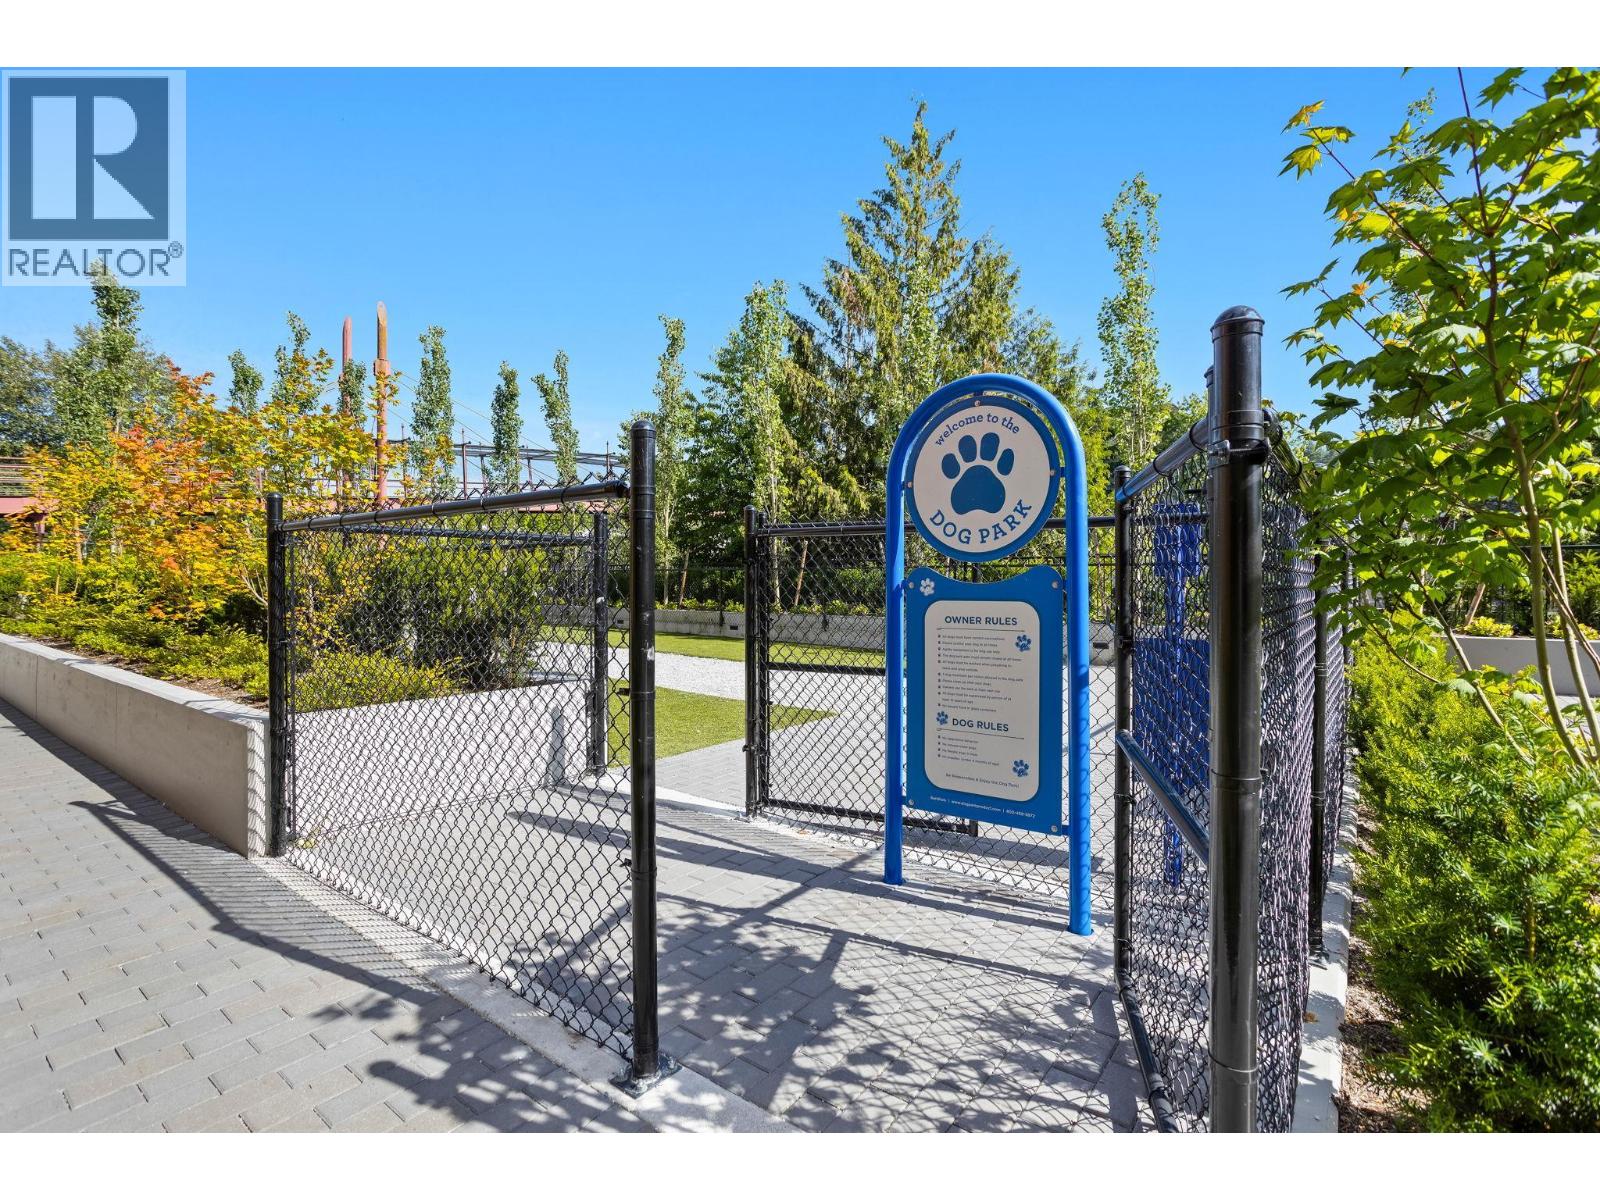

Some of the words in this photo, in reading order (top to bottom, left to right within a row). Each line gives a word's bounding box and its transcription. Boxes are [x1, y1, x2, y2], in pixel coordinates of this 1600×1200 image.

[935, 413, 984, 447] welcome
[987, 412, 999, 424] to
[1001, 416, 1020, 435] the
[929, 509, 972, 545] DOG
[978, 499, 1033, 544] PARK
[944, 615, 982, 625] OWNER
[984, 616, 1018, 626] RULES
[952, 718, 974, 728] DOG
[976, 720, 1009, 732] RULES
